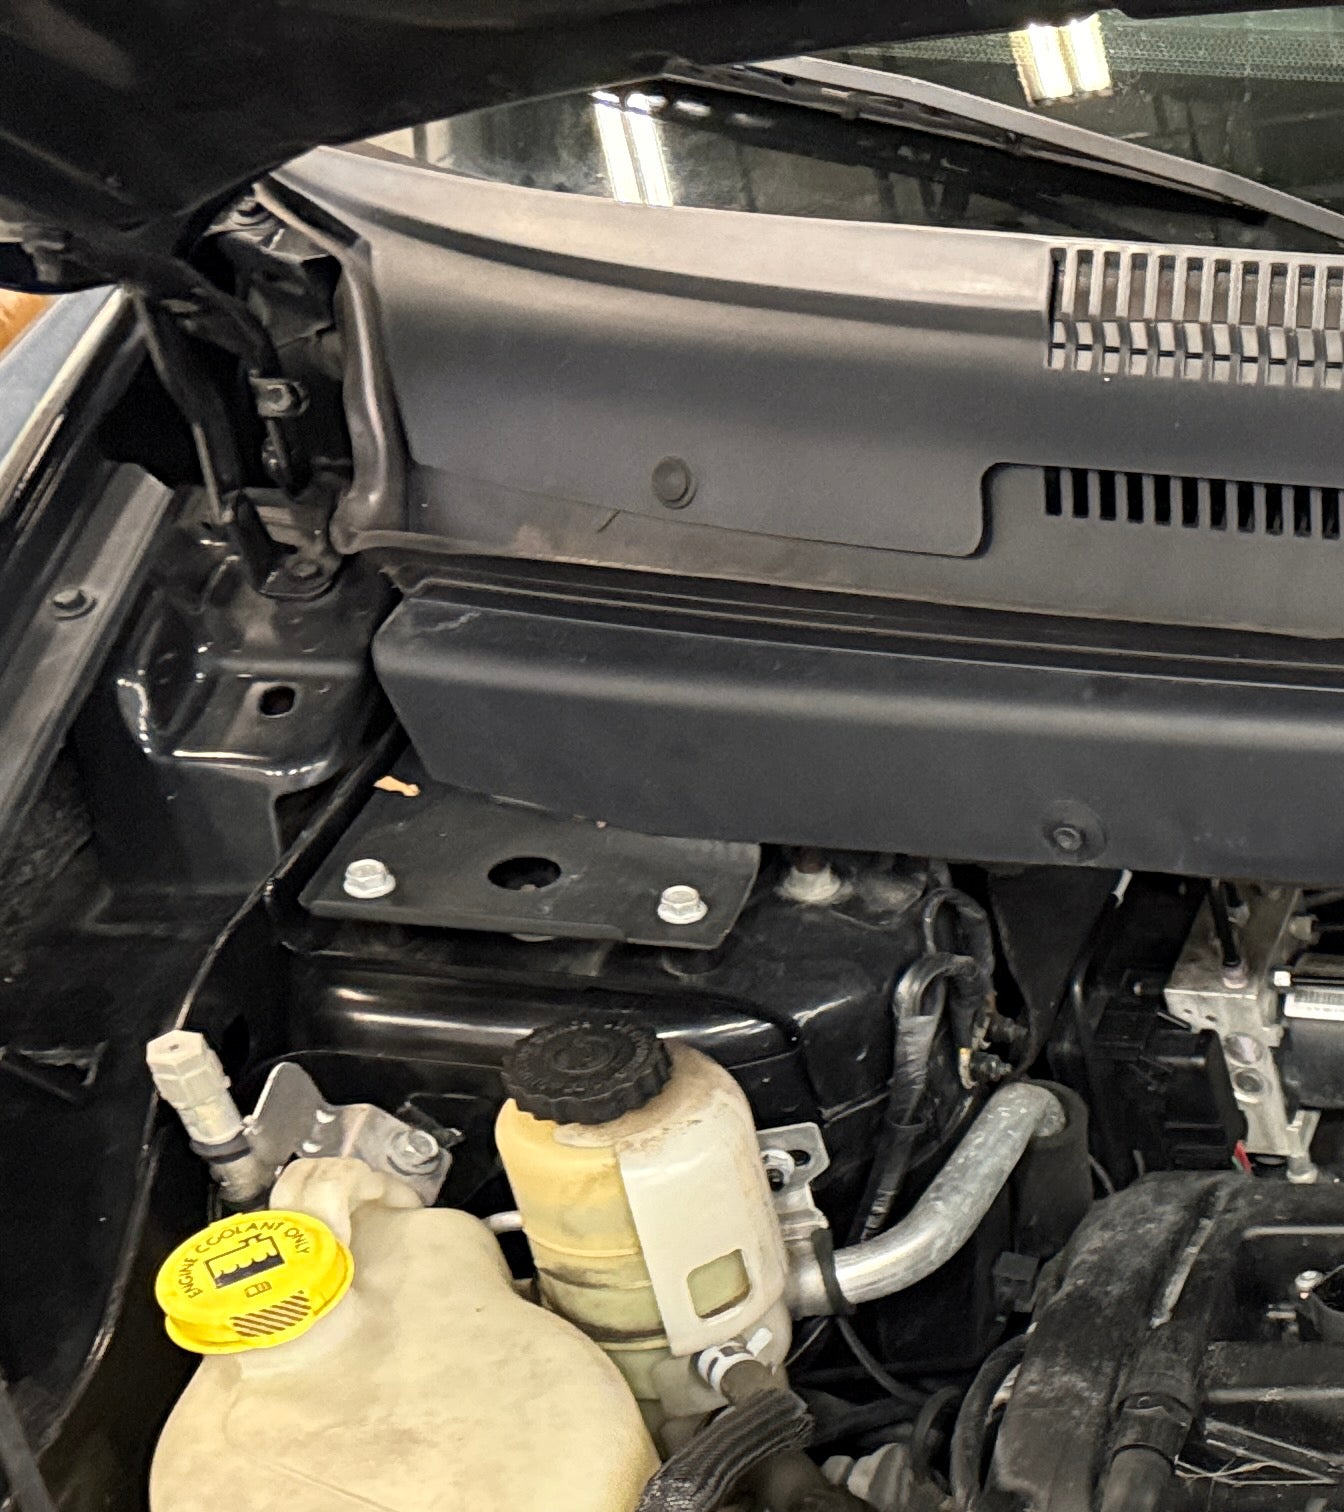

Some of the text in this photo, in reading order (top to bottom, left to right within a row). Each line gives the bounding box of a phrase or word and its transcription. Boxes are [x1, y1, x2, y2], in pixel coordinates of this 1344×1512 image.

[178, 1221, 310, 1299] ENGINE COOLANT ONLY
